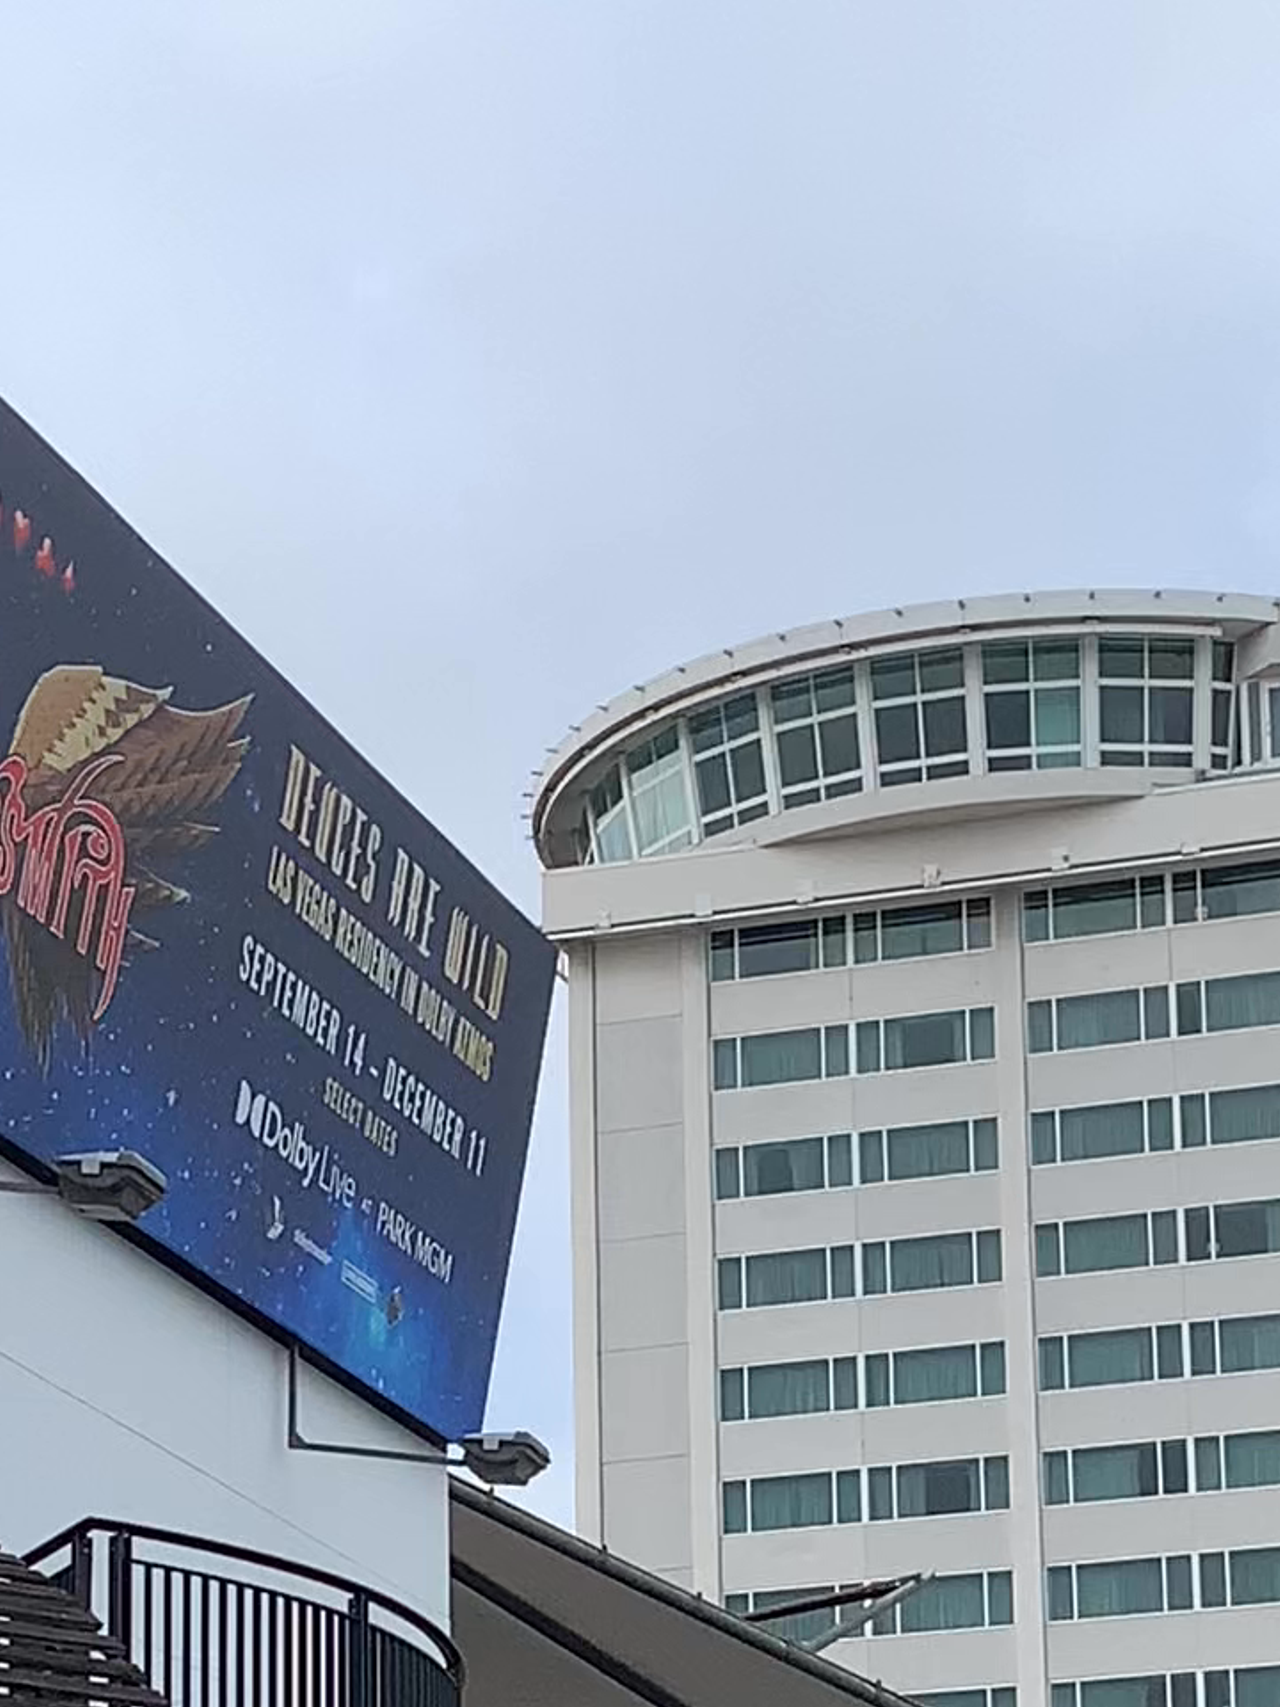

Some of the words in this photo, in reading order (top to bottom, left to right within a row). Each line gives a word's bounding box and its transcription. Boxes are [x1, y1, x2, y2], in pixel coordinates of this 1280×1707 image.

[268, 846, 295, 905] LAS
[295, 870, 336, 942] VEGAS
[335, 908, 404, 1000] RESIDENCY
[400, 965, 419, 1016] IN
[417, 979, 458, 1047] DOLBY
[453, 1015, 495, 1082] ATMOS
[279, 743, 381, 903] DEUCES
[388, 847, 441, 958] ARE
[443, 906, 509, 1021] WILD
[239, 935, 341, 1055] SEPTEMBER
[344, 1024, 366, 1076] 14
[383, 1057, 464, 1160] DECEMBER
[467, 1129, 487, 1177] 11
[323, 1077, 364, 1129] SELECT
[364, 1109, 398, 1157] DATES
[263, 1101, 320, 1187] Dolby
[319, 1145, 356, 1208] Live
[376, 1201, 414, 1256] PARK
[413, 1231, 454, 1284] MGM
